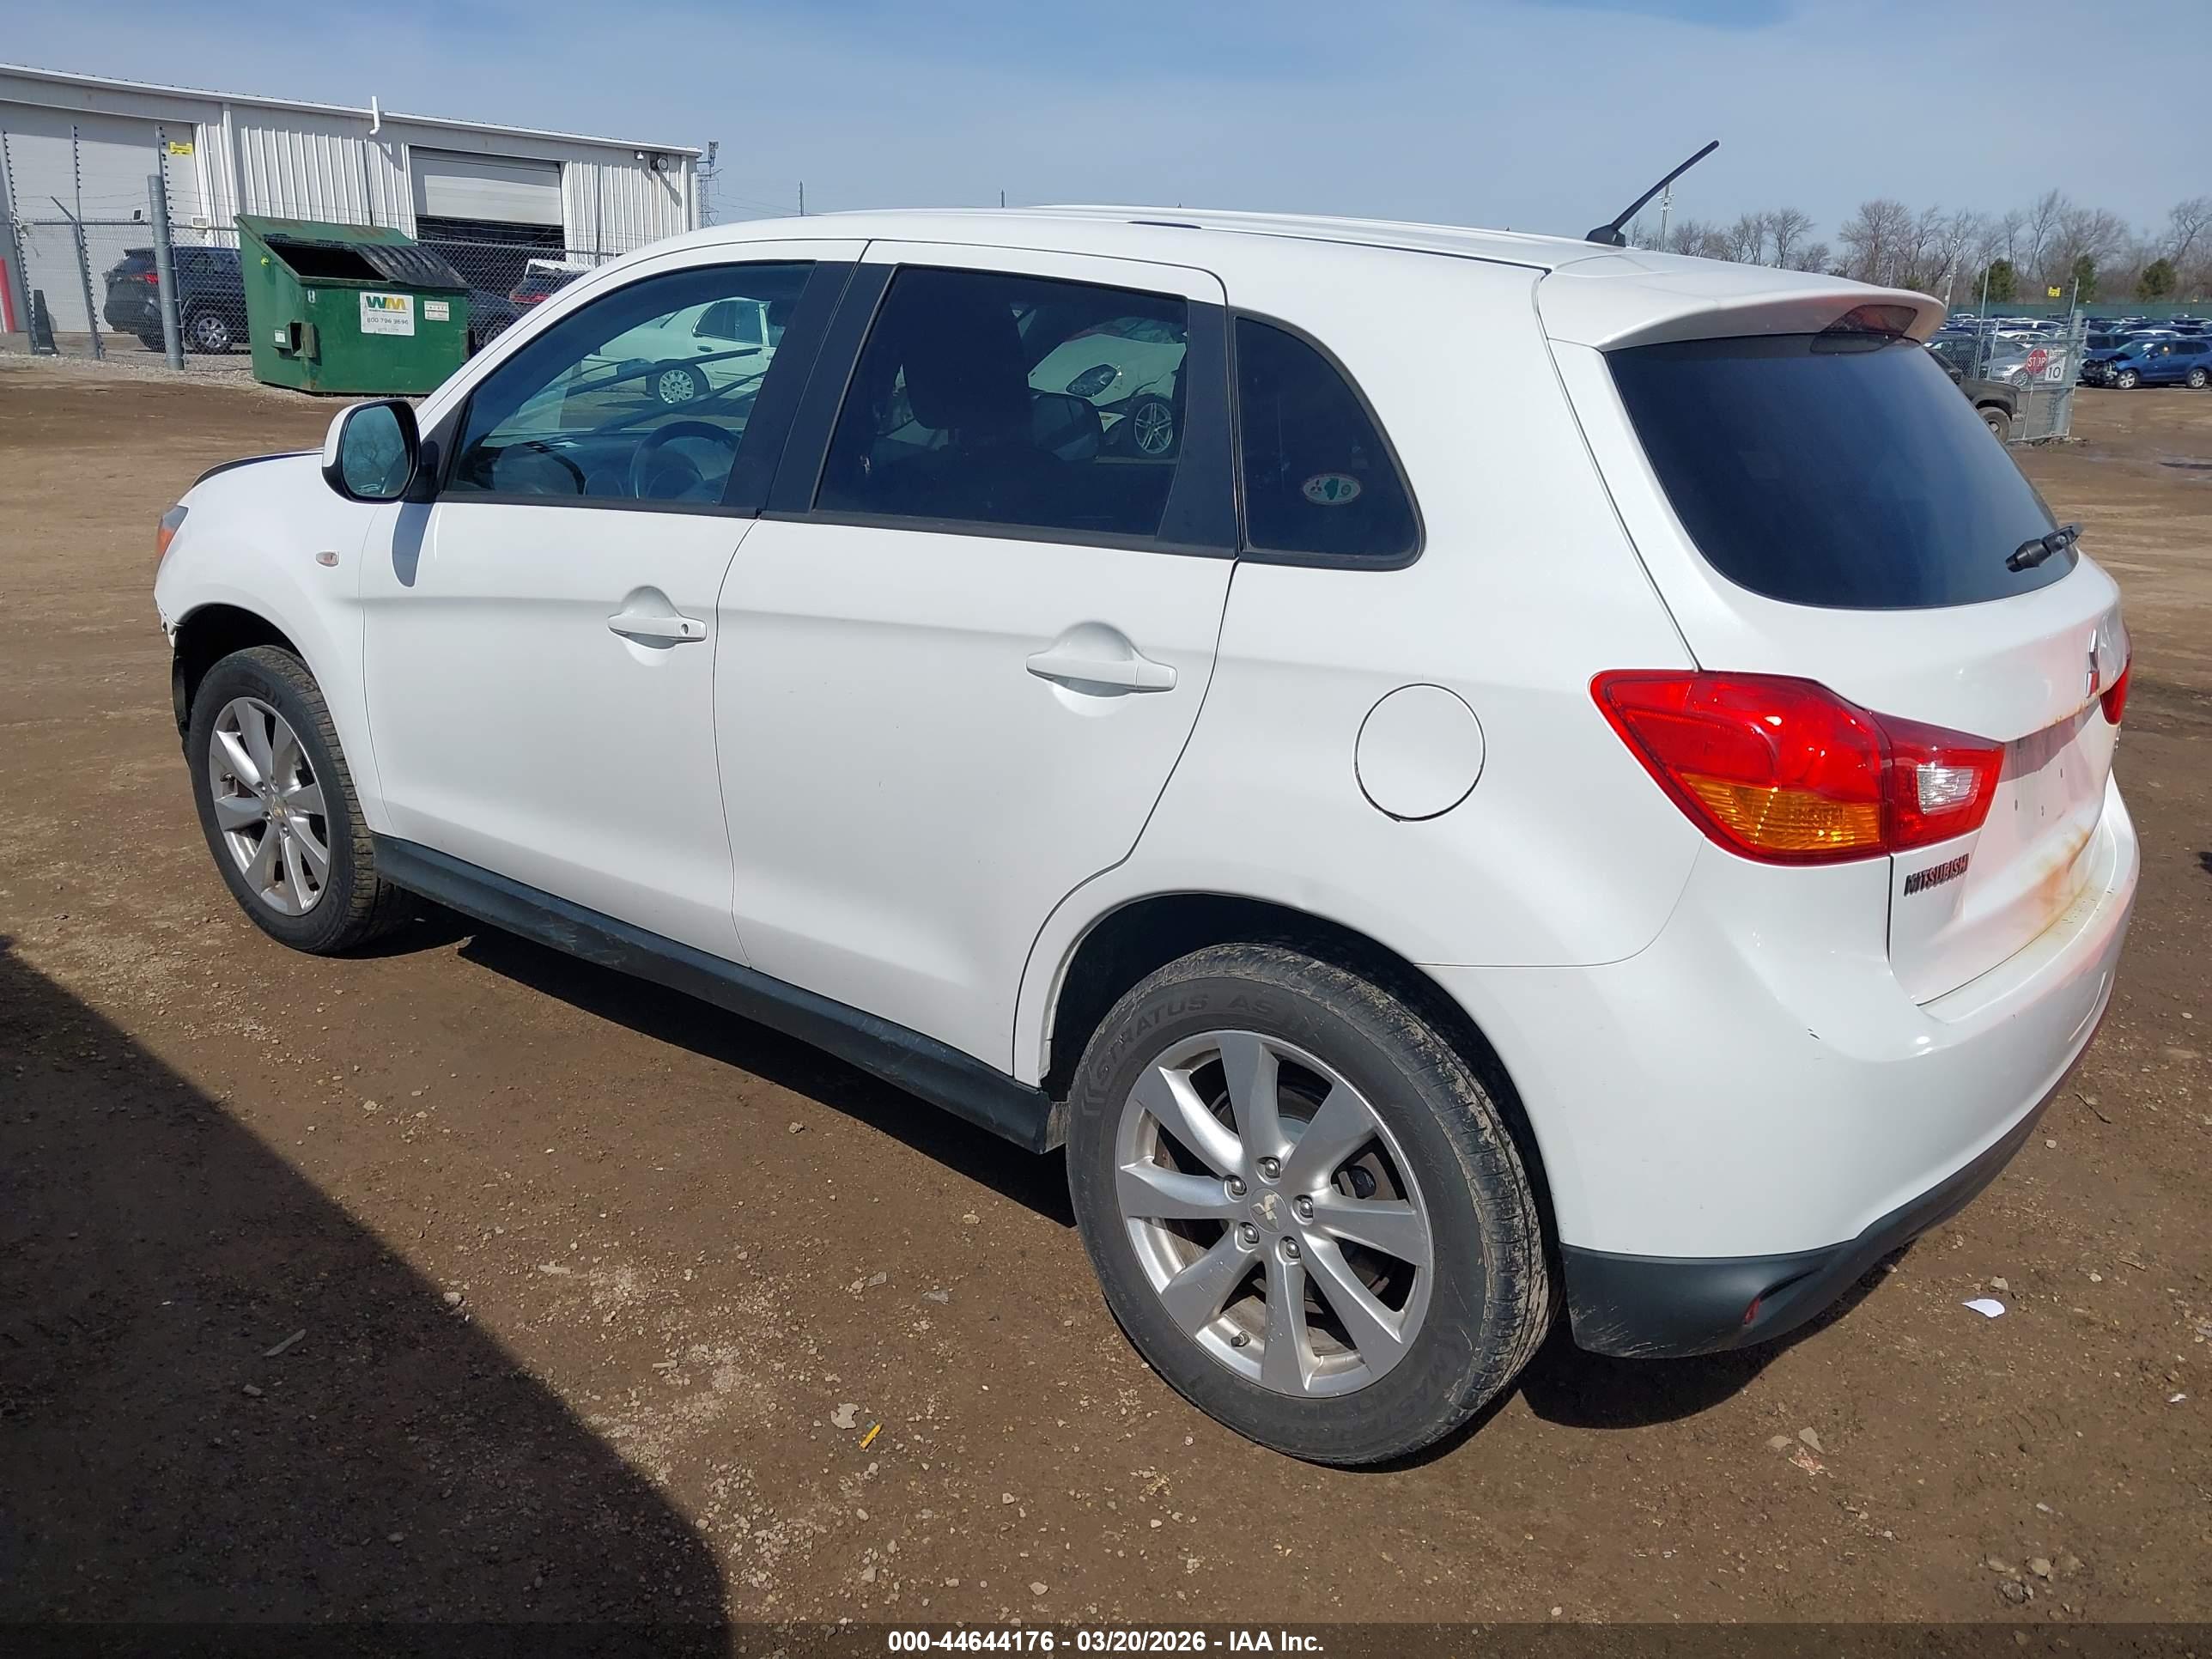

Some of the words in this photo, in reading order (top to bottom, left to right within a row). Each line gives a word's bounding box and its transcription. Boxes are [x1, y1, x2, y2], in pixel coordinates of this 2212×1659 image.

[365, 295, 406, 310] WM
[2048, 367, 2061, 379] 10
[1904, 853, 1970, 896] MITSUBISHI
[1095, 993, 1209, 1084] STRATUS
[1227, 994, 1275, 1016] AS
